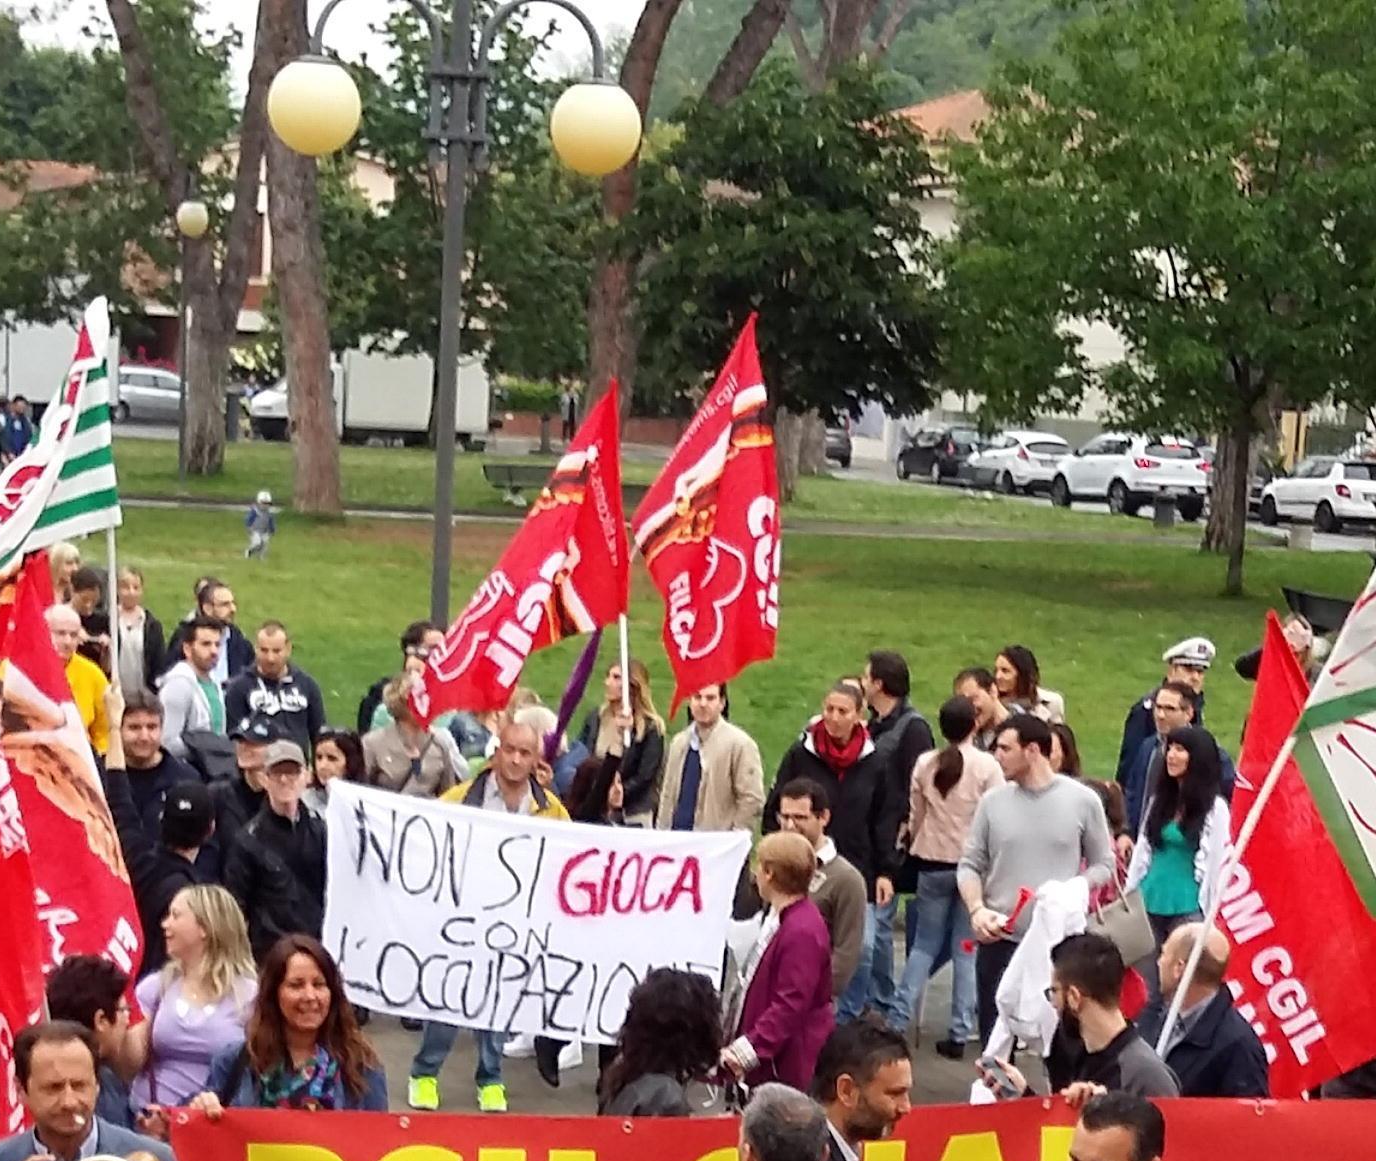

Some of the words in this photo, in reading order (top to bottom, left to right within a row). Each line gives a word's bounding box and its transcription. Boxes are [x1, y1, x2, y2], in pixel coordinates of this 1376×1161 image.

[354, 799, 473, 908] NON
[482, 833, 546, 918] SI
[556, 847, 704, 918] GIOCA
[337, 926, 719, 1037] L'OCCUPAZIO
[440, 915, 552, 955] CON
[1251, 946, 1327, 1066] CGIL
